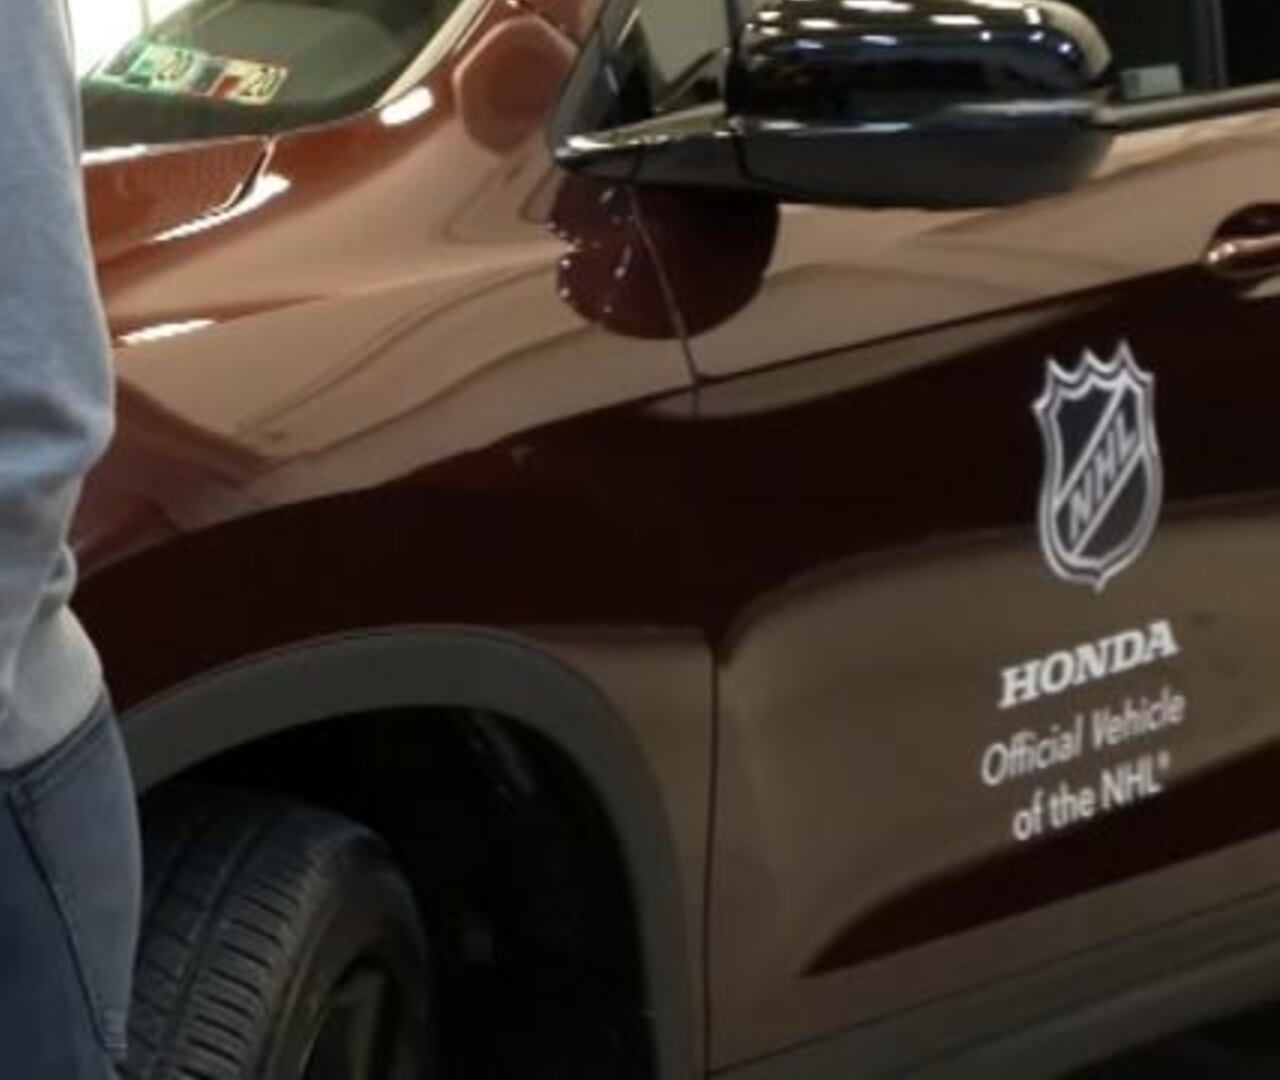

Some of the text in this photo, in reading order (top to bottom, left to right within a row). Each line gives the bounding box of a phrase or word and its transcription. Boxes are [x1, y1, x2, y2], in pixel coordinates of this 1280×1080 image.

[1067, 407, 1138, 545] NHL
[997, 619, 1179, 709] HONDA
[981, 686, 1186, 786] Official Vehicle
[1012, 789, 1045, 841] of
[1048, 781, 1096, 829] the
